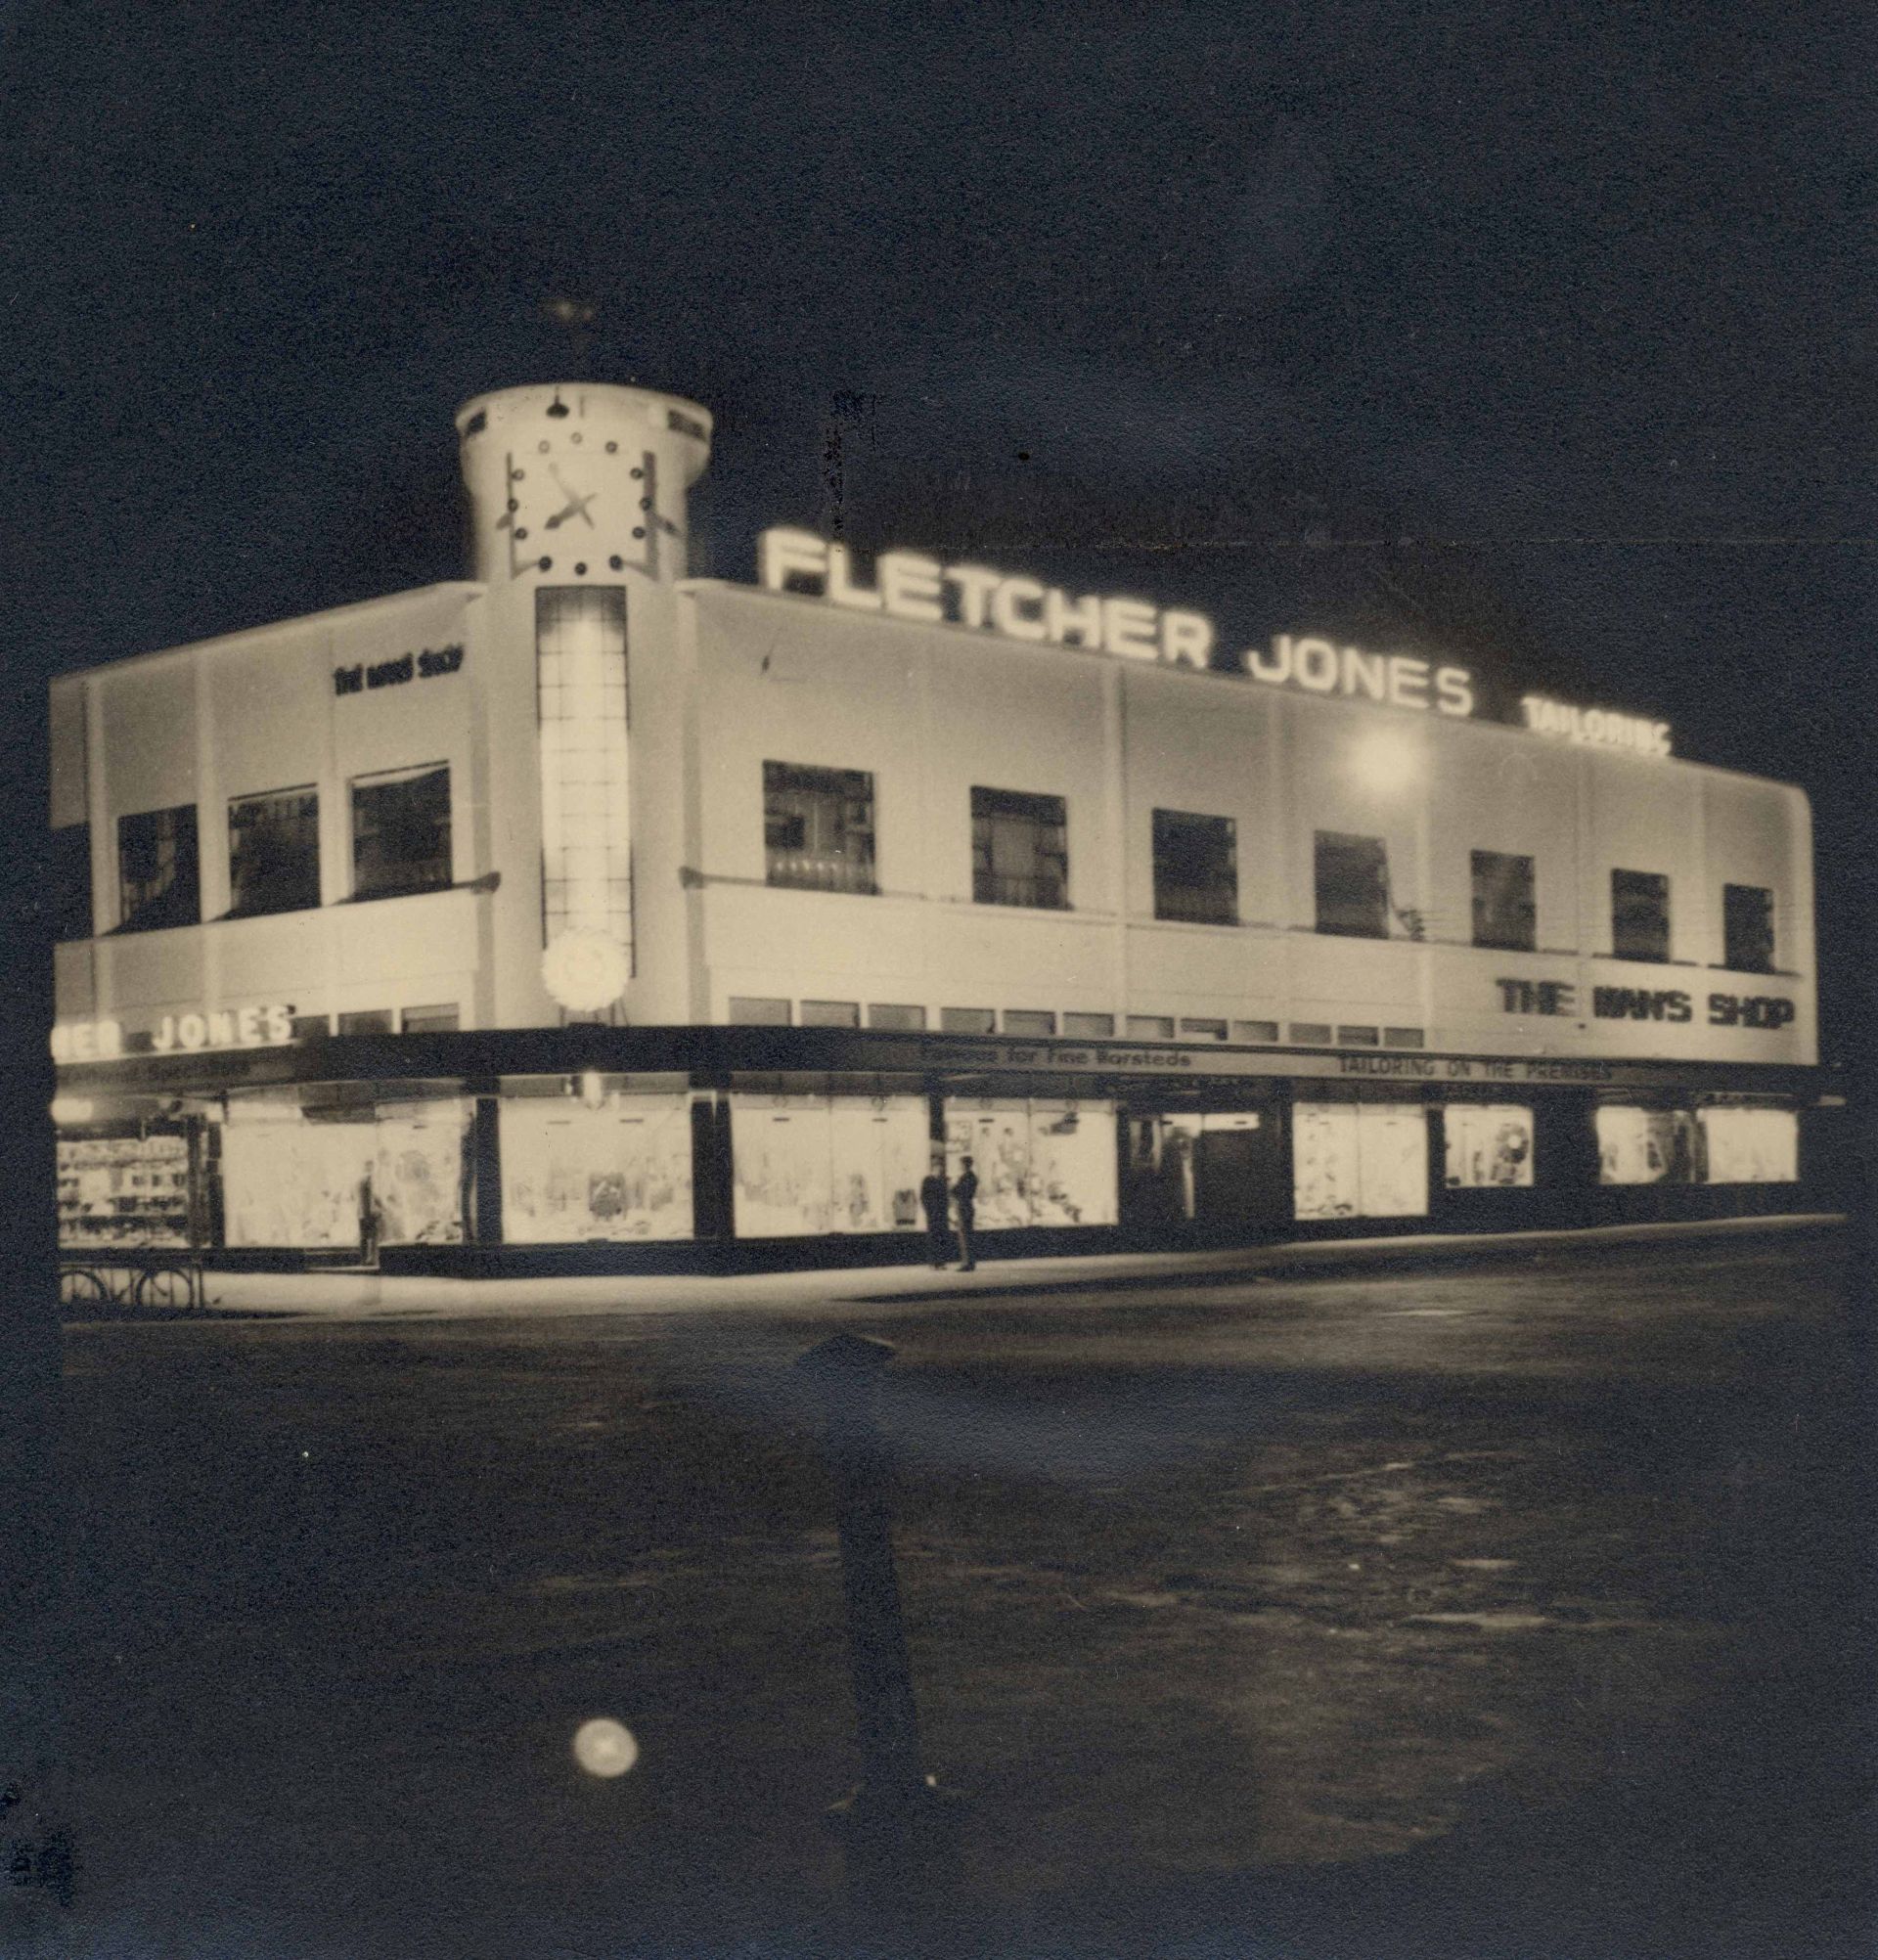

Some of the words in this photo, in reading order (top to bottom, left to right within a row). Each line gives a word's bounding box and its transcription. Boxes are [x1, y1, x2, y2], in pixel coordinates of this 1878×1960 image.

[761, 526, 1213, 669] FLETCHER
[1246, 634, 1475, 717] JONES
[1496, 978, 1576, 1016] THE
[1708, 993, 1796, 1028] SHOP
[152, 1005, 293, 1049] JONES
[1006, 1045, 1037, 1062] for
[1047, 1045, 1088, 1065] Fine
[1339, 1055, 1436, 1077] TAILORING
[1447, 1059, 1472, 1078] ON
[1484, 1060, 1514, 1078] THE
